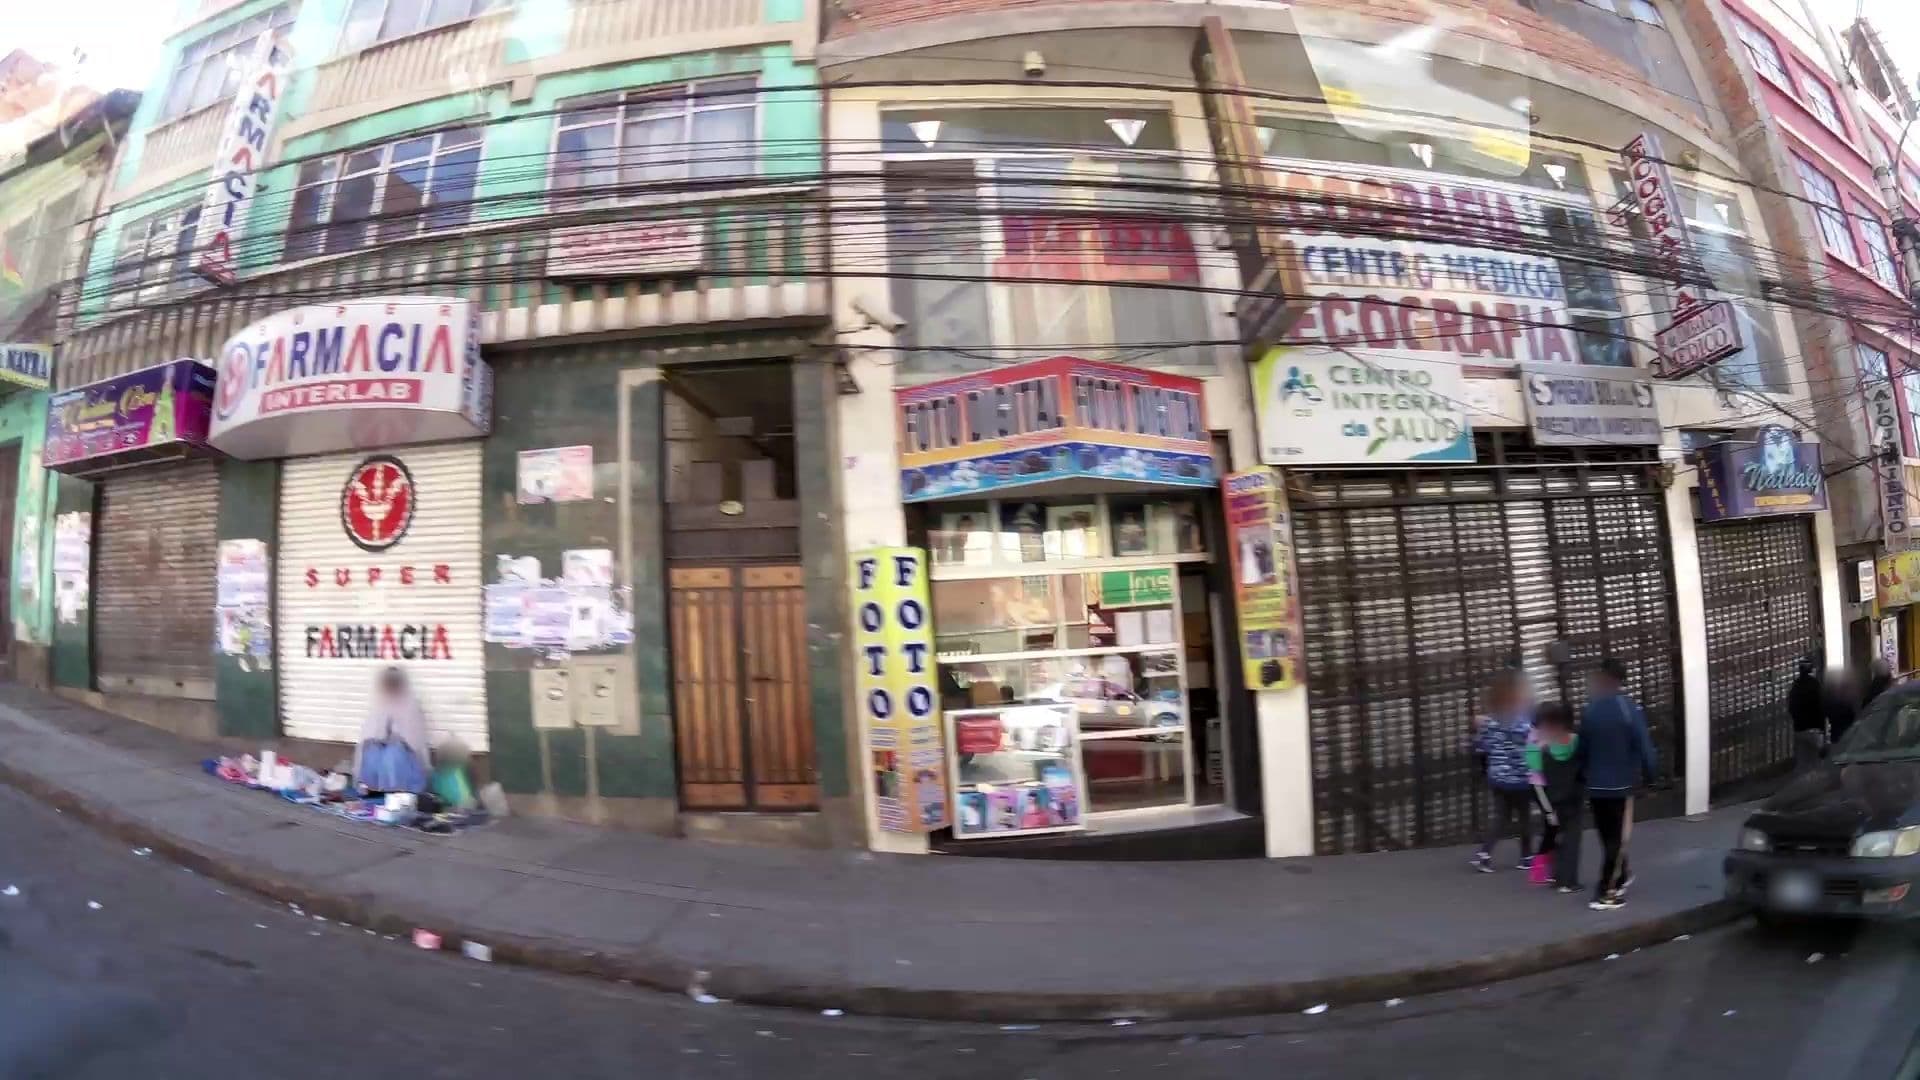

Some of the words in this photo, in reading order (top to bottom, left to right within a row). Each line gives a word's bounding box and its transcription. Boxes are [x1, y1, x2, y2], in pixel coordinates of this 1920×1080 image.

[249, 322, 455, 390] FARMACIA
[264, 381, 412, 410] INTERLAB
[1331, 390, 1457, 413] INTEGRAL
[1373, 416, 1459, 443] SALUD
[304, 563, 452, 589] SUPER
[304, 623, 454, 661] FARMACIA
[856, 559, 894, 720] FOTO
[892, 555, 932, 718] FOTO
